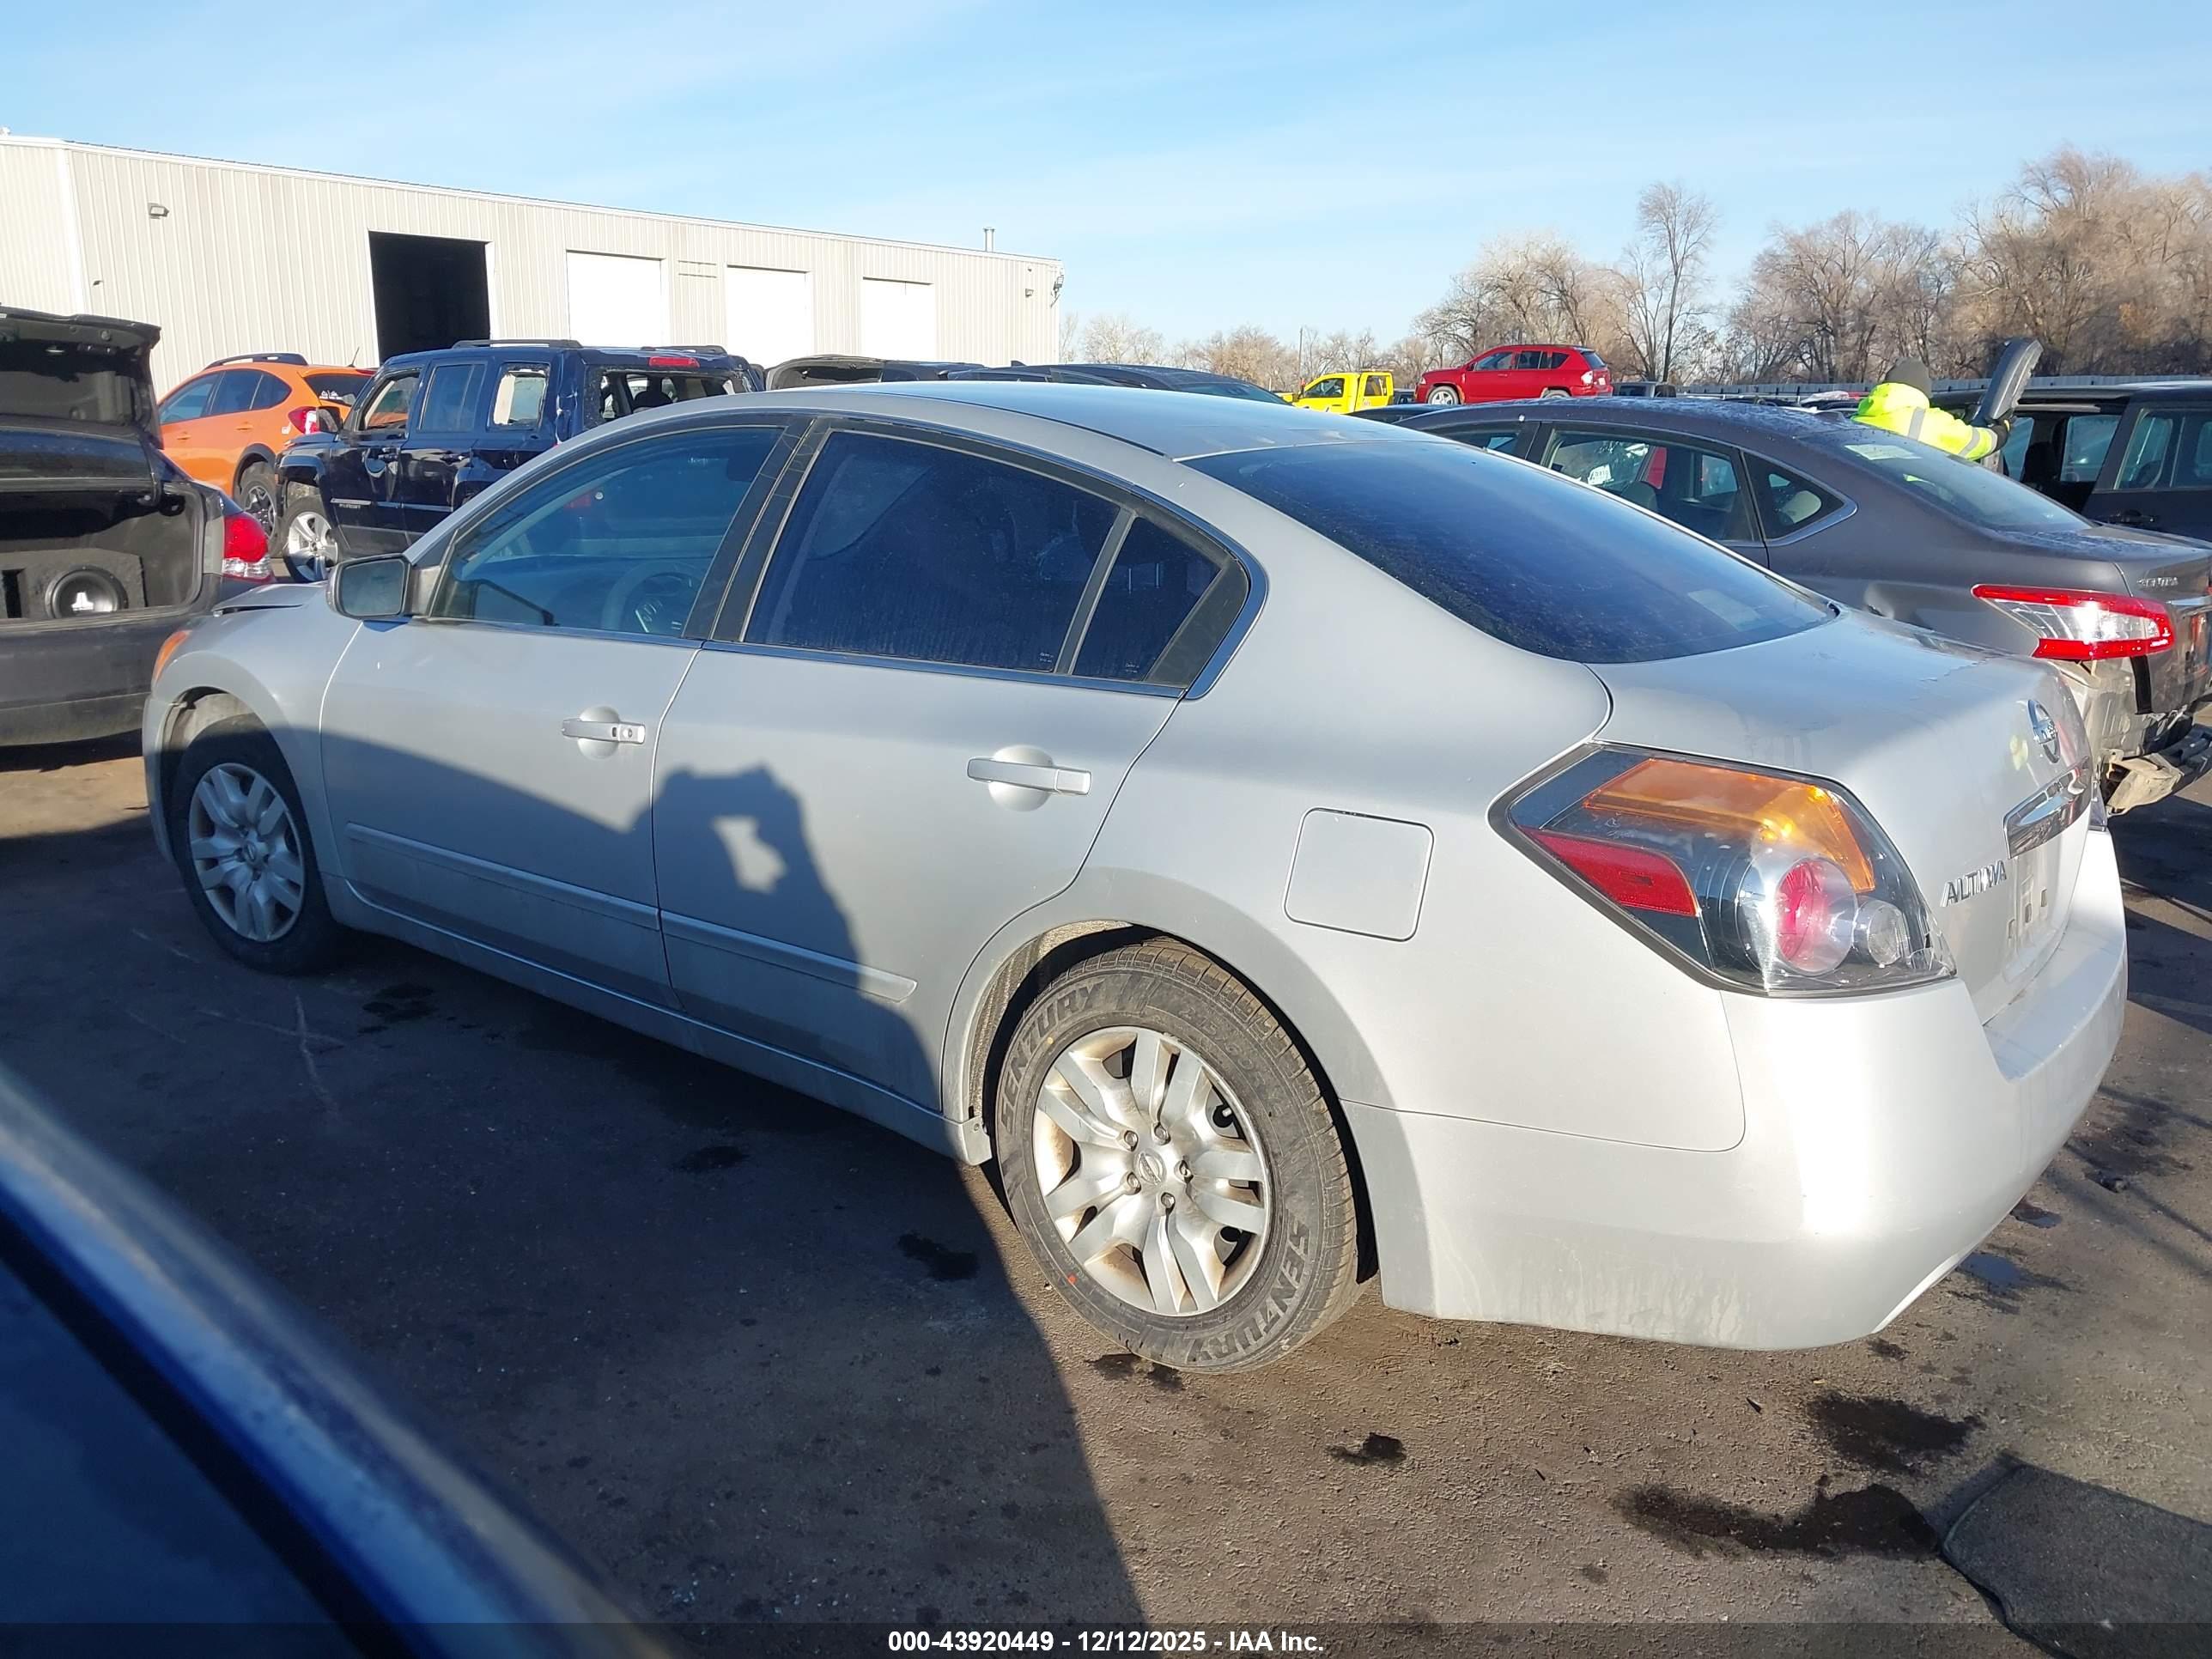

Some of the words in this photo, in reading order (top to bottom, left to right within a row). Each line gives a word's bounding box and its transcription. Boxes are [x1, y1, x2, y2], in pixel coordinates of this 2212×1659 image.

[1940, 860, 2008, 908] ALTIMA
[1000, 977, 1106, 1136] SENTURY
[1186, 1209, 1310, 1364] SENTURY
